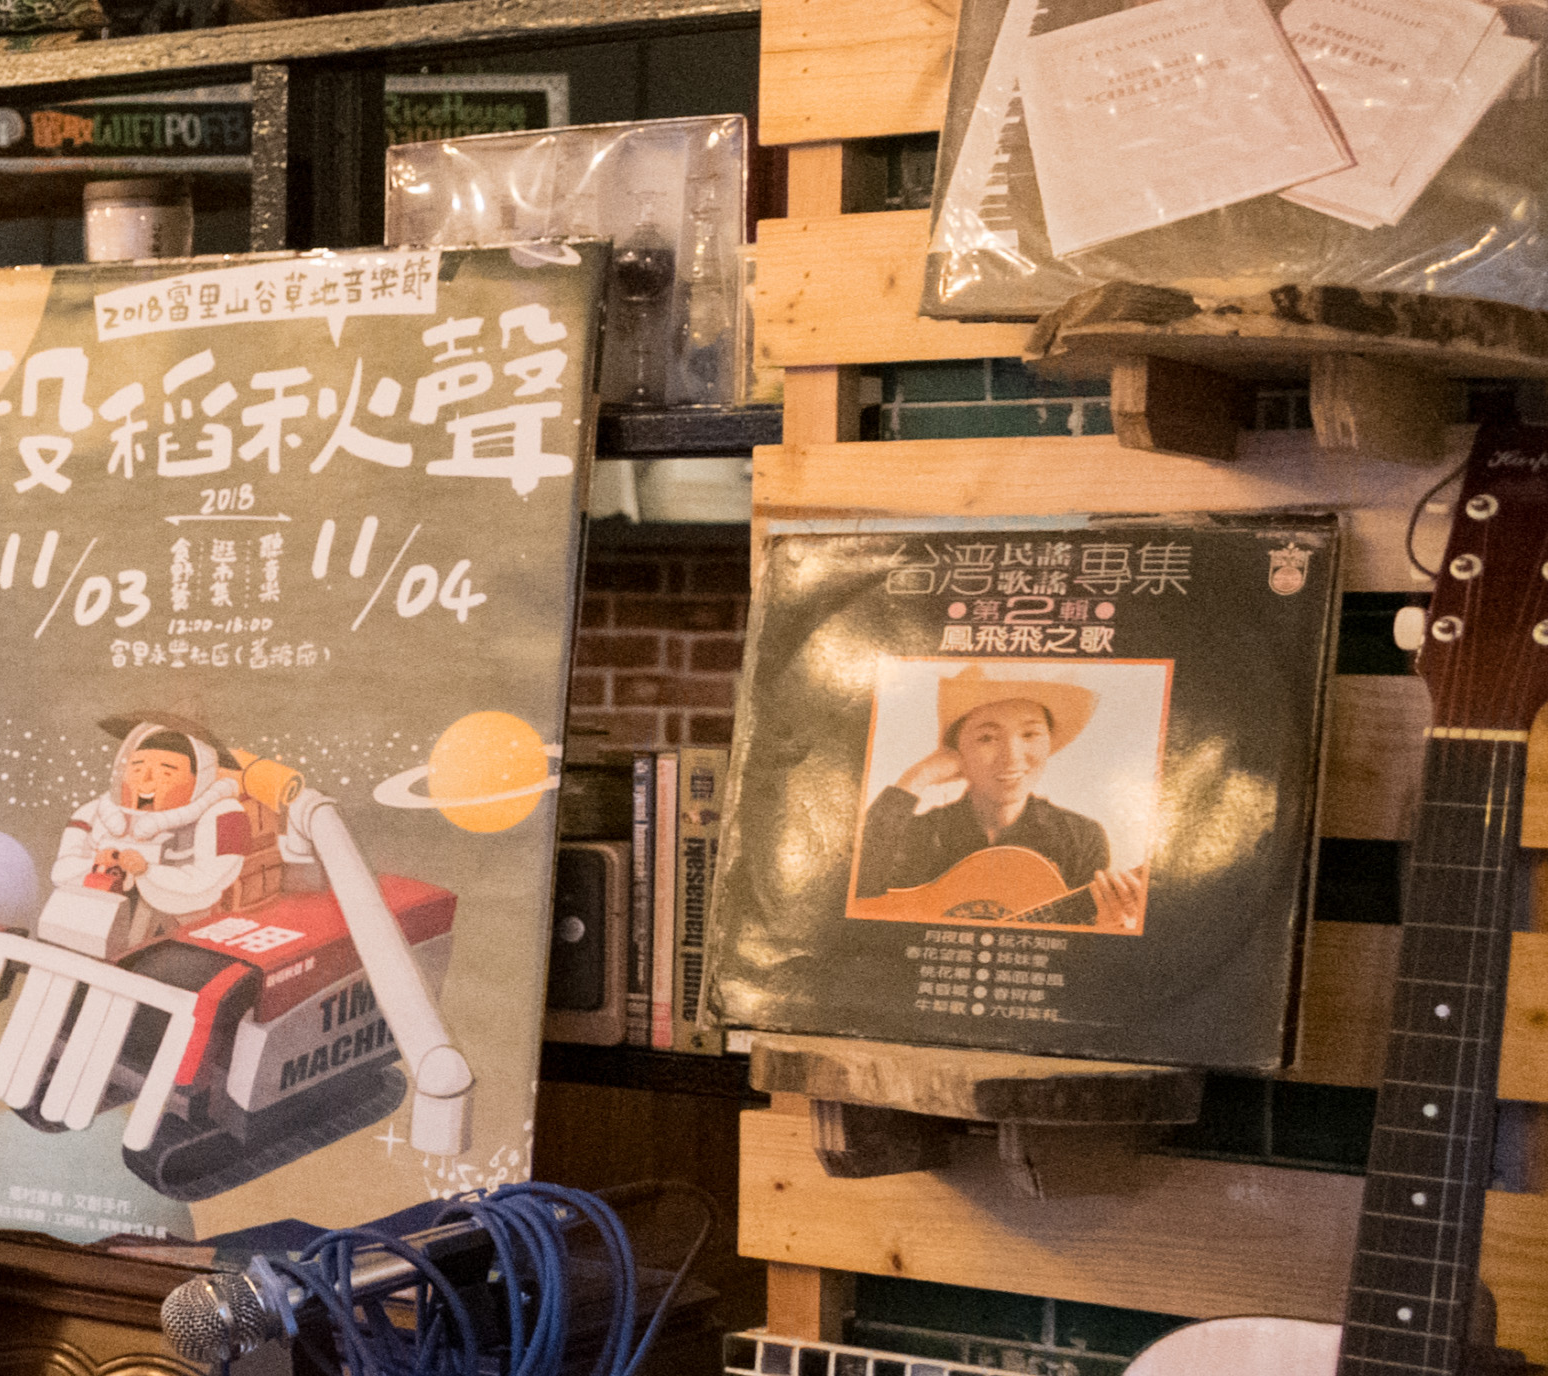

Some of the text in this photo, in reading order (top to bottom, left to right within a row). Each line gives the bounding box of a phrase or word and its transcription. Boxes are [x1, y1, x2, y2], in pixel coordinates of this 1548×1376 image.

[93, 113, 163, 147] WIFI
[101, 256, 433, 330] 2018富里山谷草地音樂節
[199, 482, 256, 515] 2018
[311, 515, 487, 632] 11/04
[1074, 542, 1193, 596] 專集
[940, 624, 1116, 654] 鳳飛飛之歌
[682, 838, 707, 950] hamasaki
[319, 978, 379, 1033] TIM
[279, 1017, 396, 1092] MACHI
